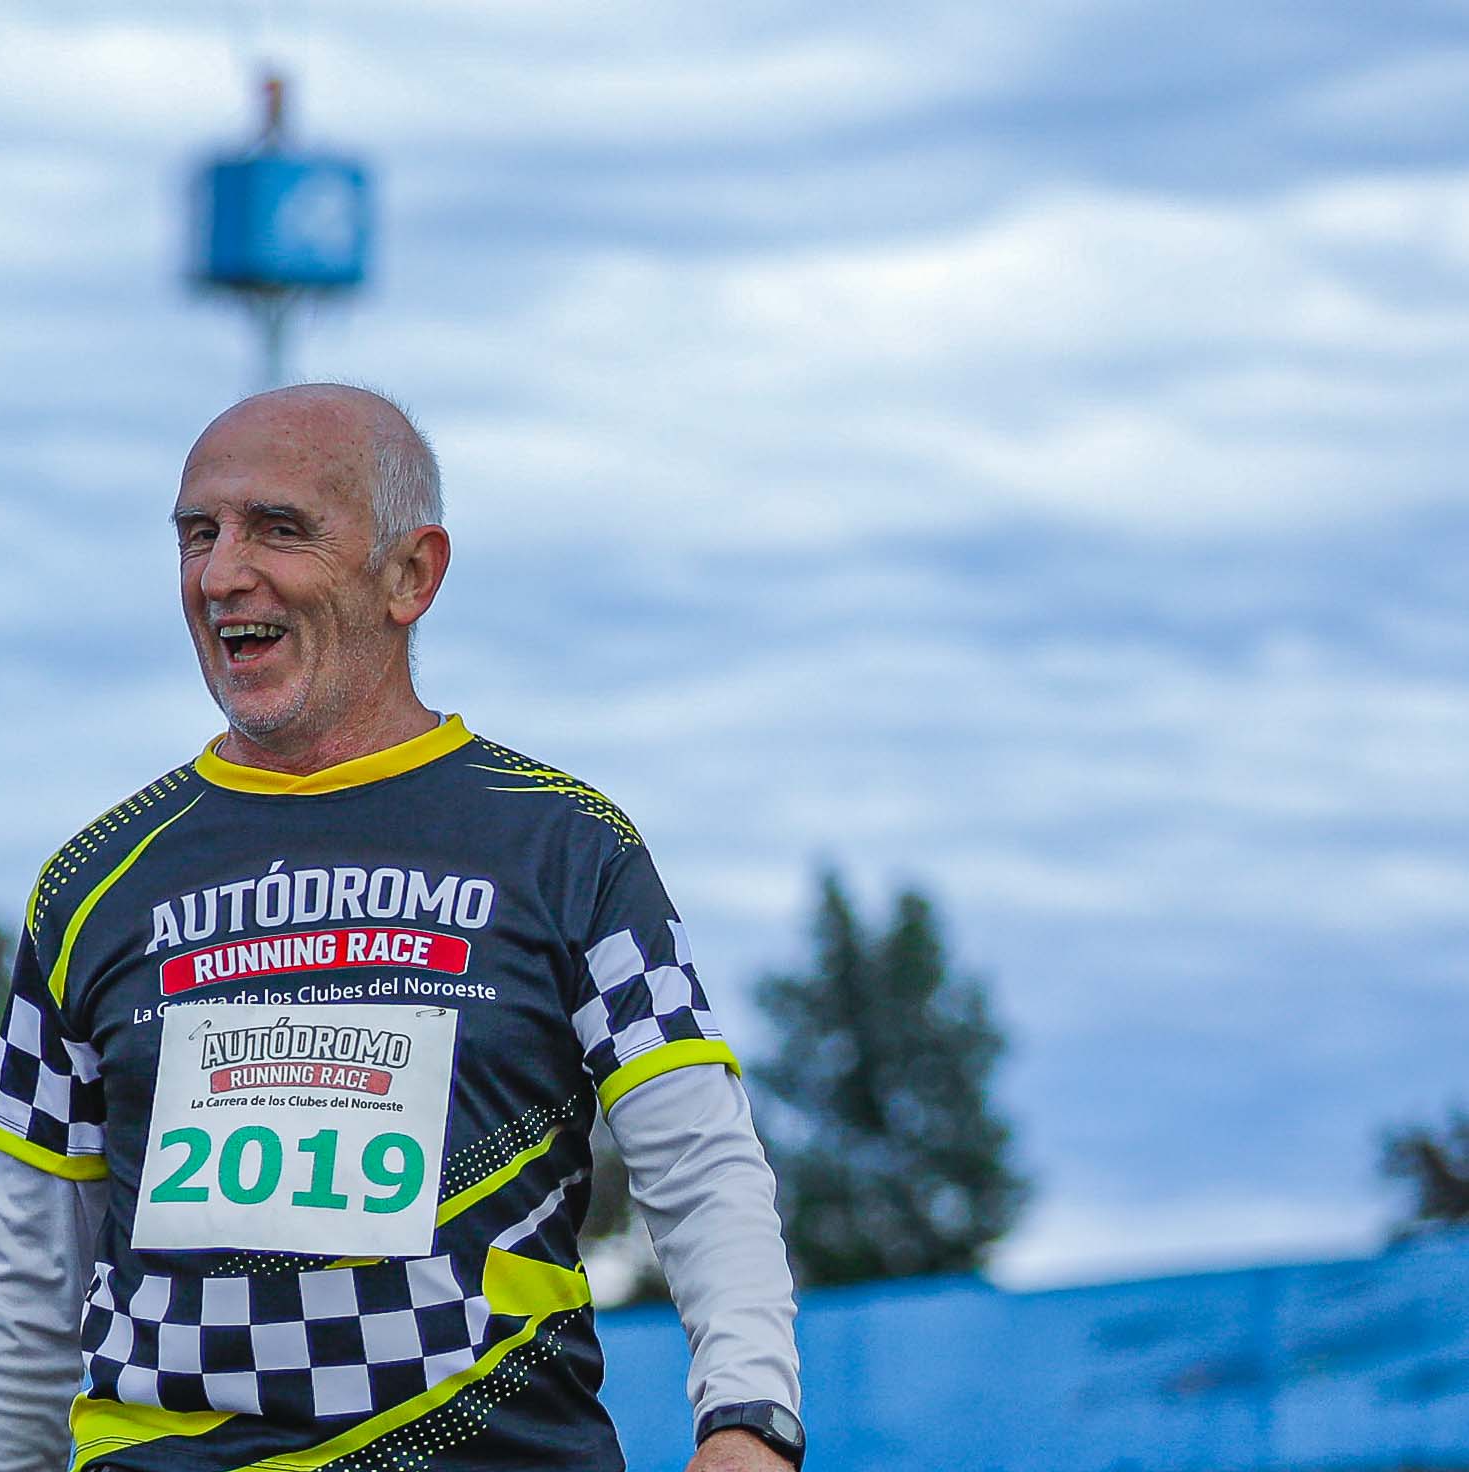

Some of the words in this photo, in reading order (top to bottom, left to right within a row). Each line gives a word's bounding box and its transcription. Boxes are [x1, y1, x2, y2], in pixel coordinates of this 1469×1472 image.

[145, 860, 495, 956] AUTÓDROMO
[193, 935, 337, 985] RUNNING
[346, 932, 433, 966] RACE
[133, 1008, 152, 1025] La
[234, 990, 258, 1005] de
[264, 988, 292, 1006] los
[299, 984, 363, 1004] Clubes
[368, 977, 398, 996] del
[404, 978, 496, 1000] Noroeste
[201, 1016, 412, 1070] AUTÓDROMO
[191, 1099, 204, 1109] La
[206, 1097, 247, 1108] Carrera
[250, 1095, 266, 1106] de
[269, 1095, 286, 1106] los
[288, 1095, 327, 1108] Clubes
[330, 1097, 349, 1109] del
[351, 1098, 403, 1112] Noroeste
[230, 1064, 314, 1088] RUNNING
[320, 1066, 371, 1090] RACE
[150, 1125, 425, 1214] 2019
